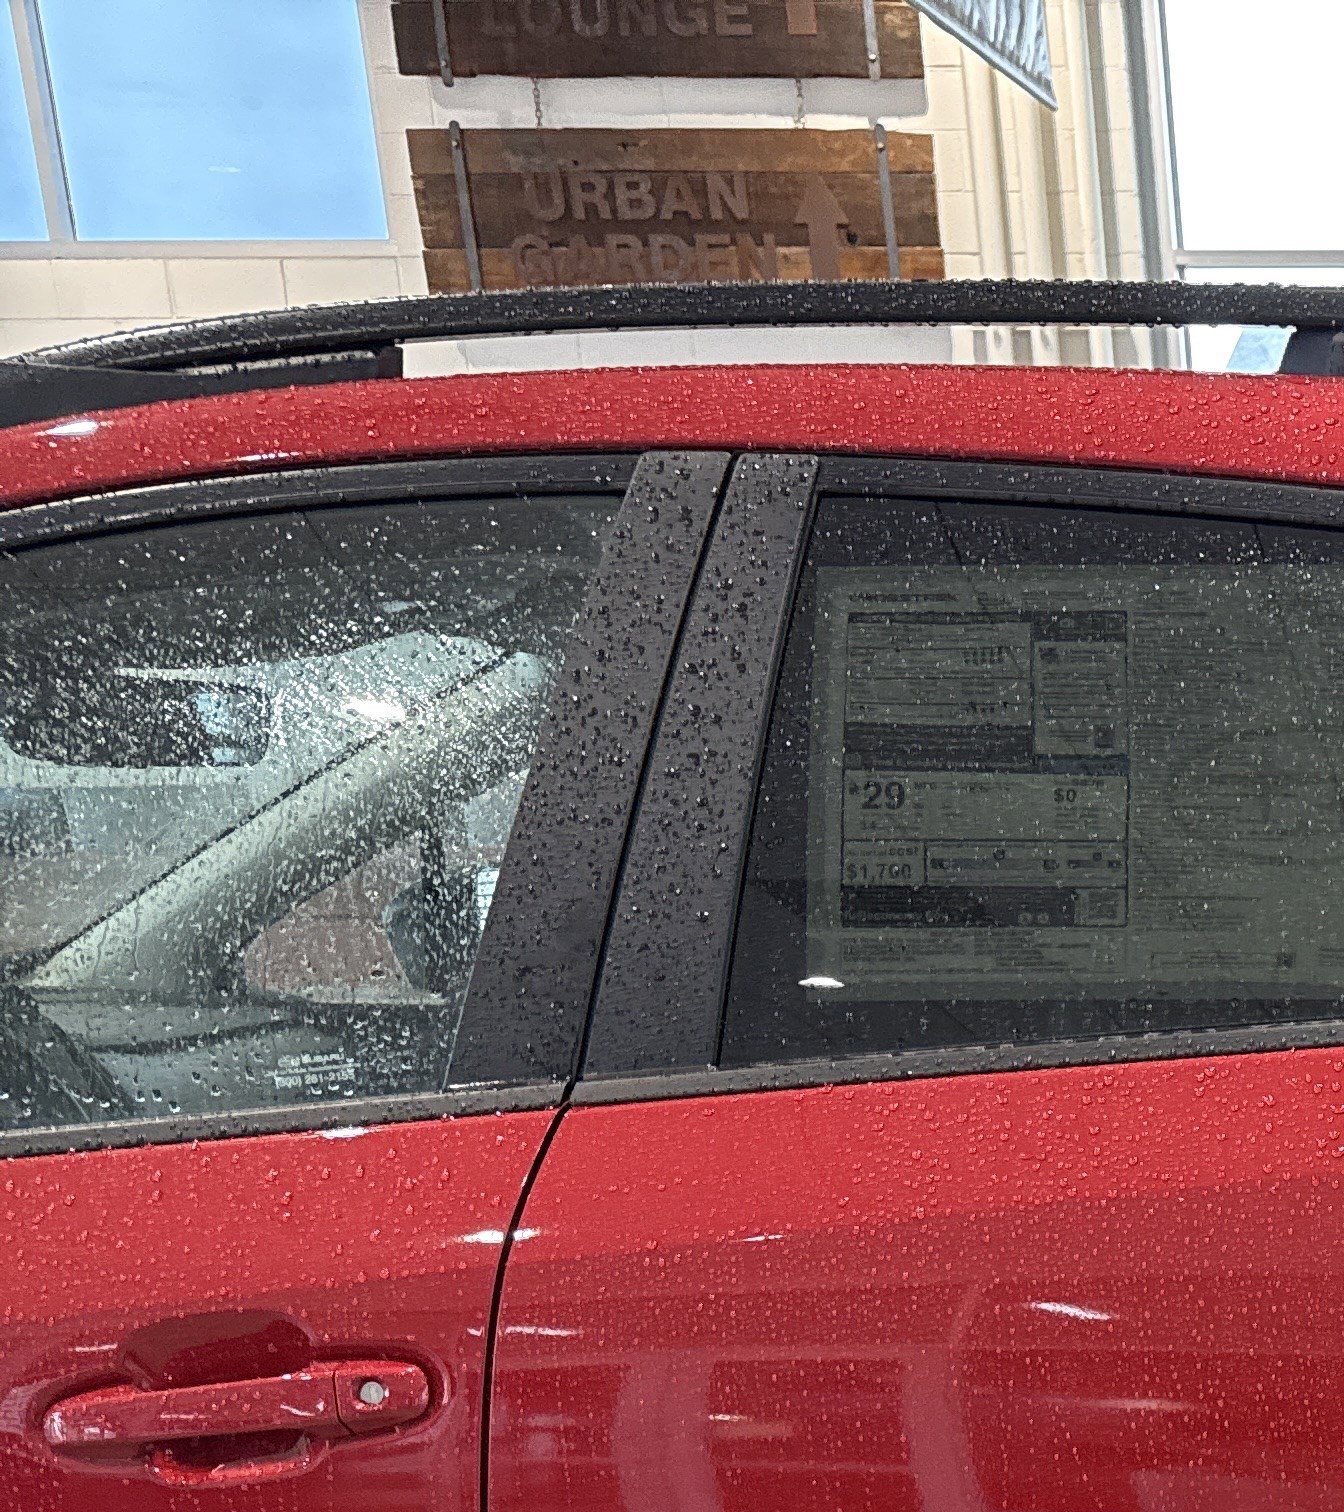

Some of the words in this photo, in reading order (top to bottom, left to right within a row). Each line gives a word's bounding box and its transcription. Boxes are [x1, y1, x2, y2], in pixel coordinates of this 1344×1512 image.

[481, 0, 753, 38] LOUNGE
[521, 171, 750, 223] URBAN
[510, 233, 779, 285] GARDEN
[861, 780, 906, 810] 29
